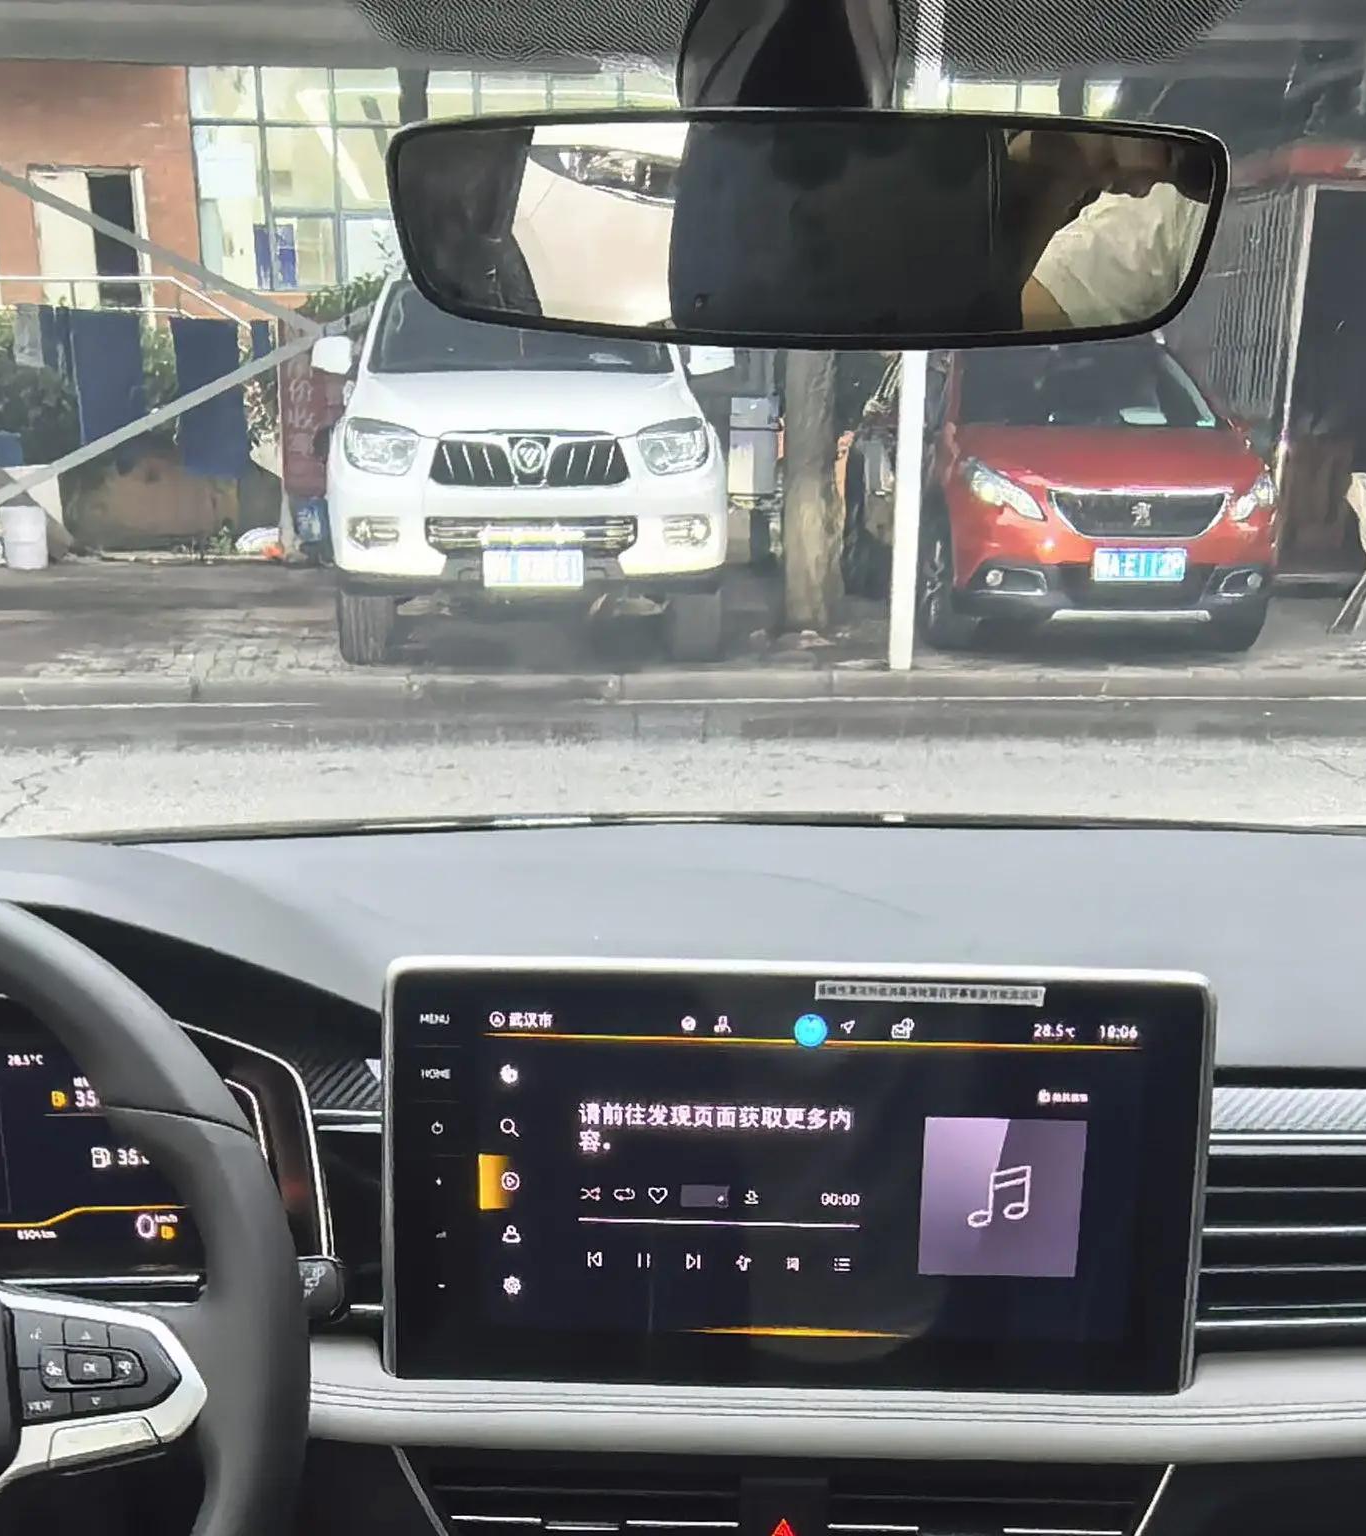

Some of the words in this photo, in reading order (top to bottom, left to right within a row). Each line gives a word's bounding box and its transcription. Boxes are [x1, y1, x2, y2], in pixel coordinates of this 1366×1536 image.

[420, 1013, 450, 1025] MENU
[509, 1011, 553, 1028] 武汉市
[1100, 1024, 1138, 1039] 18:06
[578, 1102, 853, 1132] 请前往发现页面获取更多内
[821, 1193, 861, 1207] 00:00
